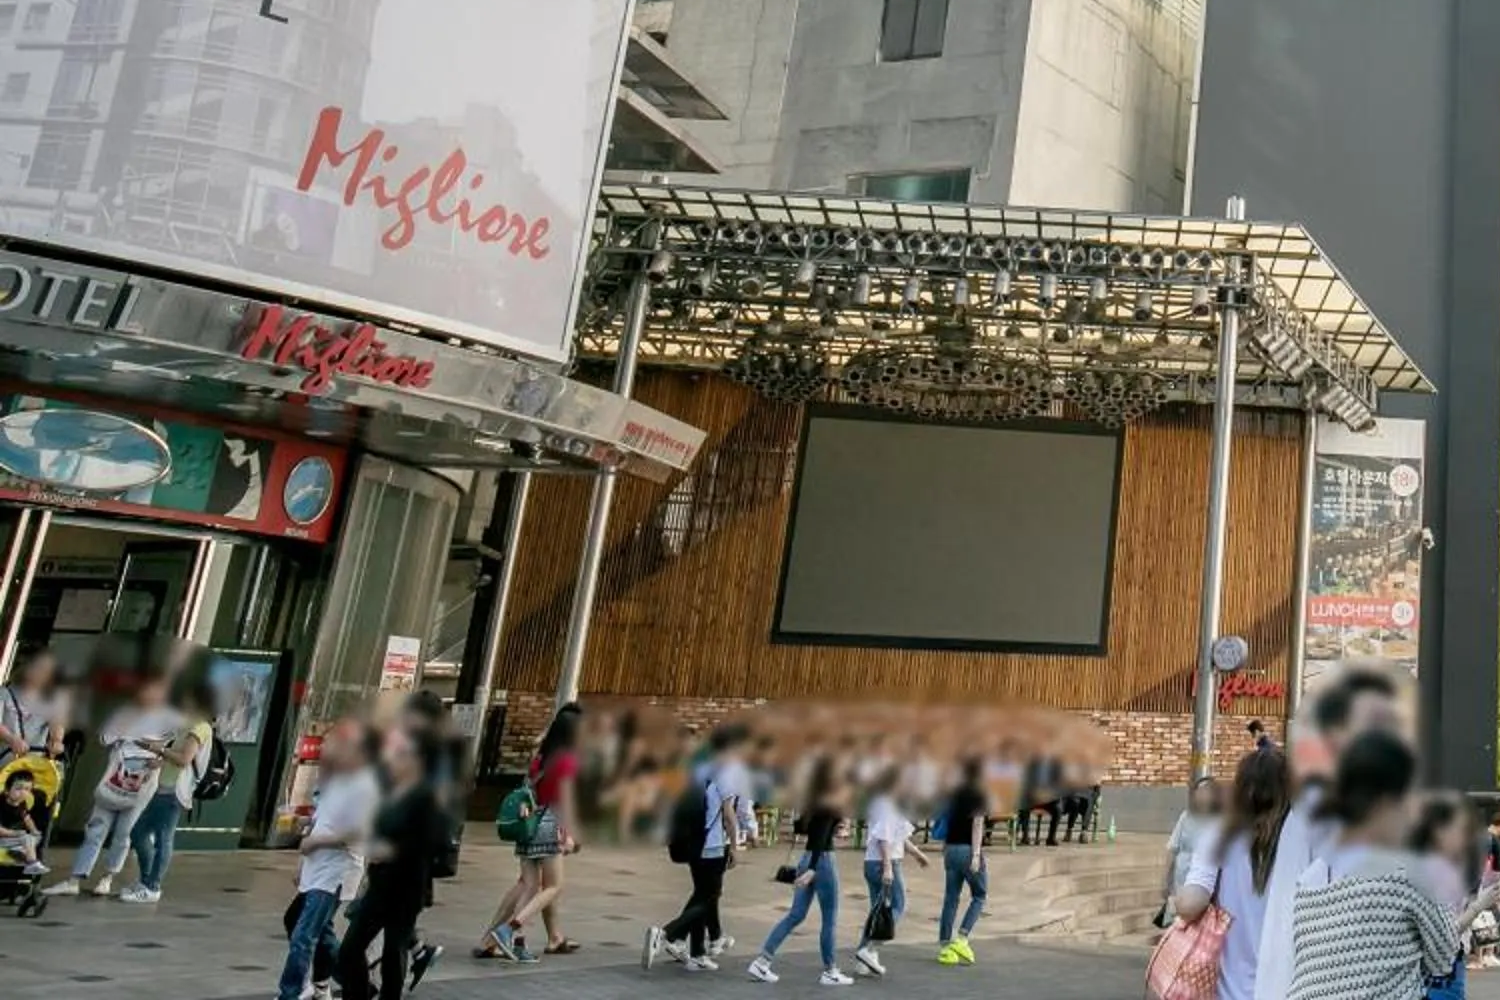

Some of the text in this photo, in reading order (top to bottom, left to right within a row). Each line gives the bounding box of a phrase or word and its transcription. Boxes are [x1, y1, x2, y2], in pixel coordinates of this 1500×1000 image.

[296, 106, 551, 260] Migliore
[241, 303, 436, 394] Migliore
[1311, 602, 1360, 618] LUNCH
